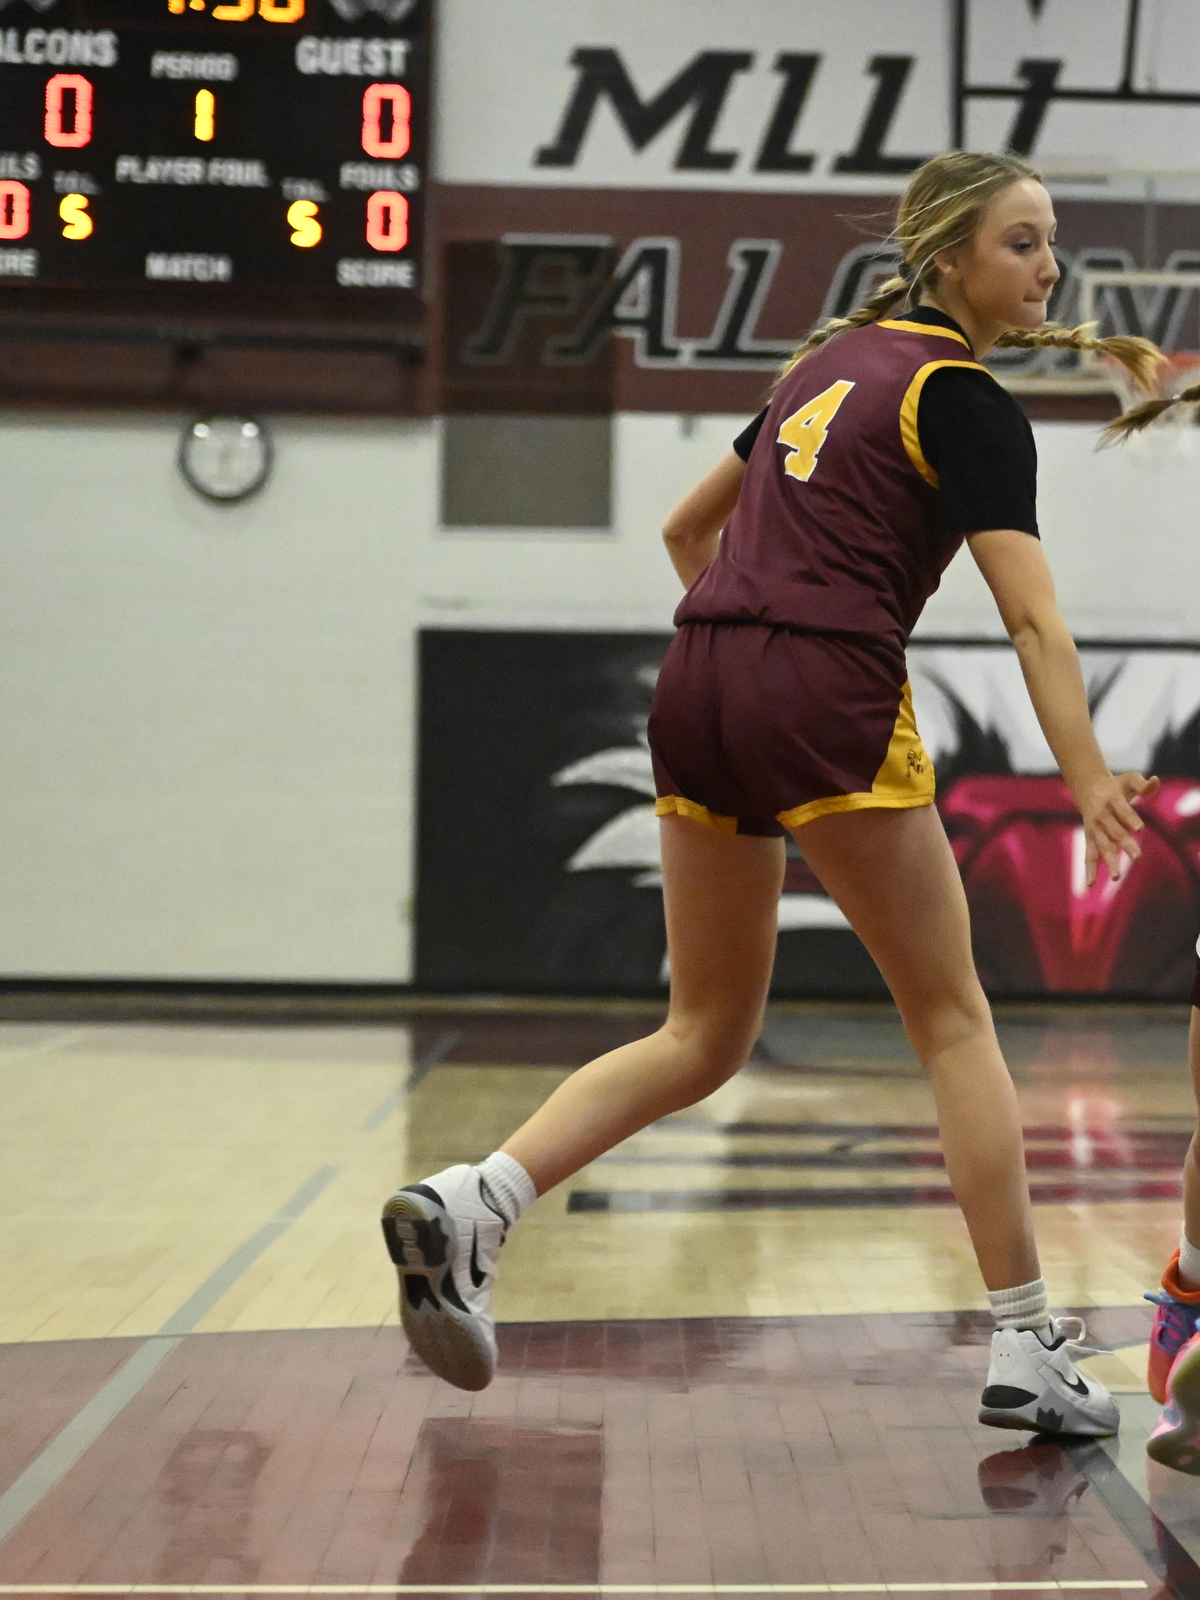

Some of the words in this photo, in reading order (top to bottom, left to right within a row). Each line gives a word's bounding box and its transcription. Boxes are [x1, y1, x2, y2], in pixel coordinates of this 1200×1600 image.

[0, 28, 118, 67] LCONS
[151, 52, 239, 81] PERIOD
[296, 36, 411, 76] GUEST
[45, 73, 93, 148] 0
[194, 89, 215, 142] 1
[362, 83, 411, 159] 0
[115, 155, 207, 186] PLAYER
[207, 157, 269, 188] FOUL
[340, 161, 420, 192] FOULS
[0, 180, 30, 239] 0
[366, 190, 409, 251] 0
[145, 253, 232, 282] MATCH
[336, 258, 416, 288] SCORE
[776, 379, 856, 482] 4
